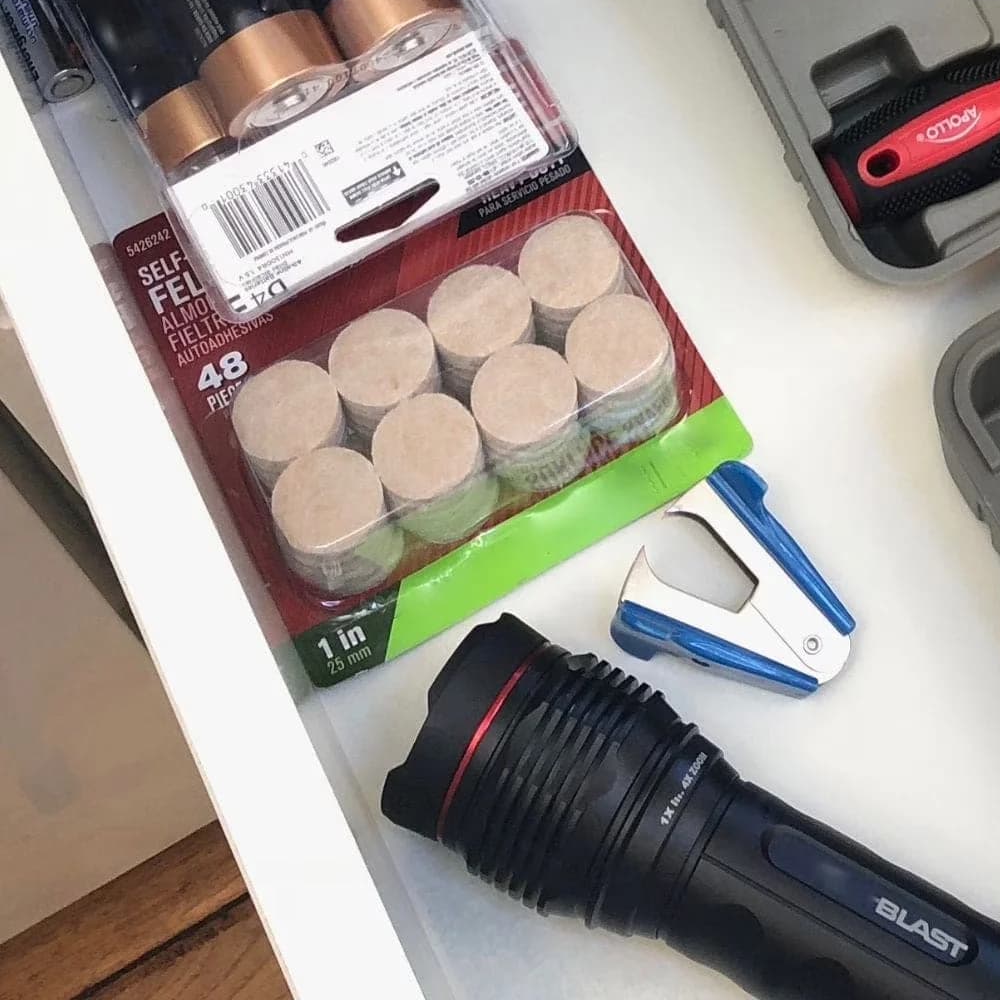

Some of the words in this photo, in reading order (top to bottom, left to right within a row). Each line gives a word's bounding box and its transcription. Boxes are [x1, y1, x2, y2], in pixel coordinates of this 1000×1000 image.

[926, 104, 976, 139] APOLLO
[478, 202, 502, 217] PARA
[502, 181, 539, 205] SERVICIO
[538, 164, 571, 186] PESADO
[126, 228, 171, 256] 5426242
[148, 271, 206, 314] FEL
[161, 297, 213, 334] ALMO
[168, 313, 228, 352] FIELTR
[177, 313, 273, 367] AUTOADHESIVAS
[198, 350, 248, 391] 48
[318, 637, 333, 659] 1
[337, 626, 366, 650] in
[327, 656, 345, 675] 25
[347, 646, 372, 665] mm
[661, 806, 675, 825] 1X
[682, 773, 693, 789] 4X
[689, 752, 708, 775] ZOOM
[874, 896, 969, 958] BLAST
